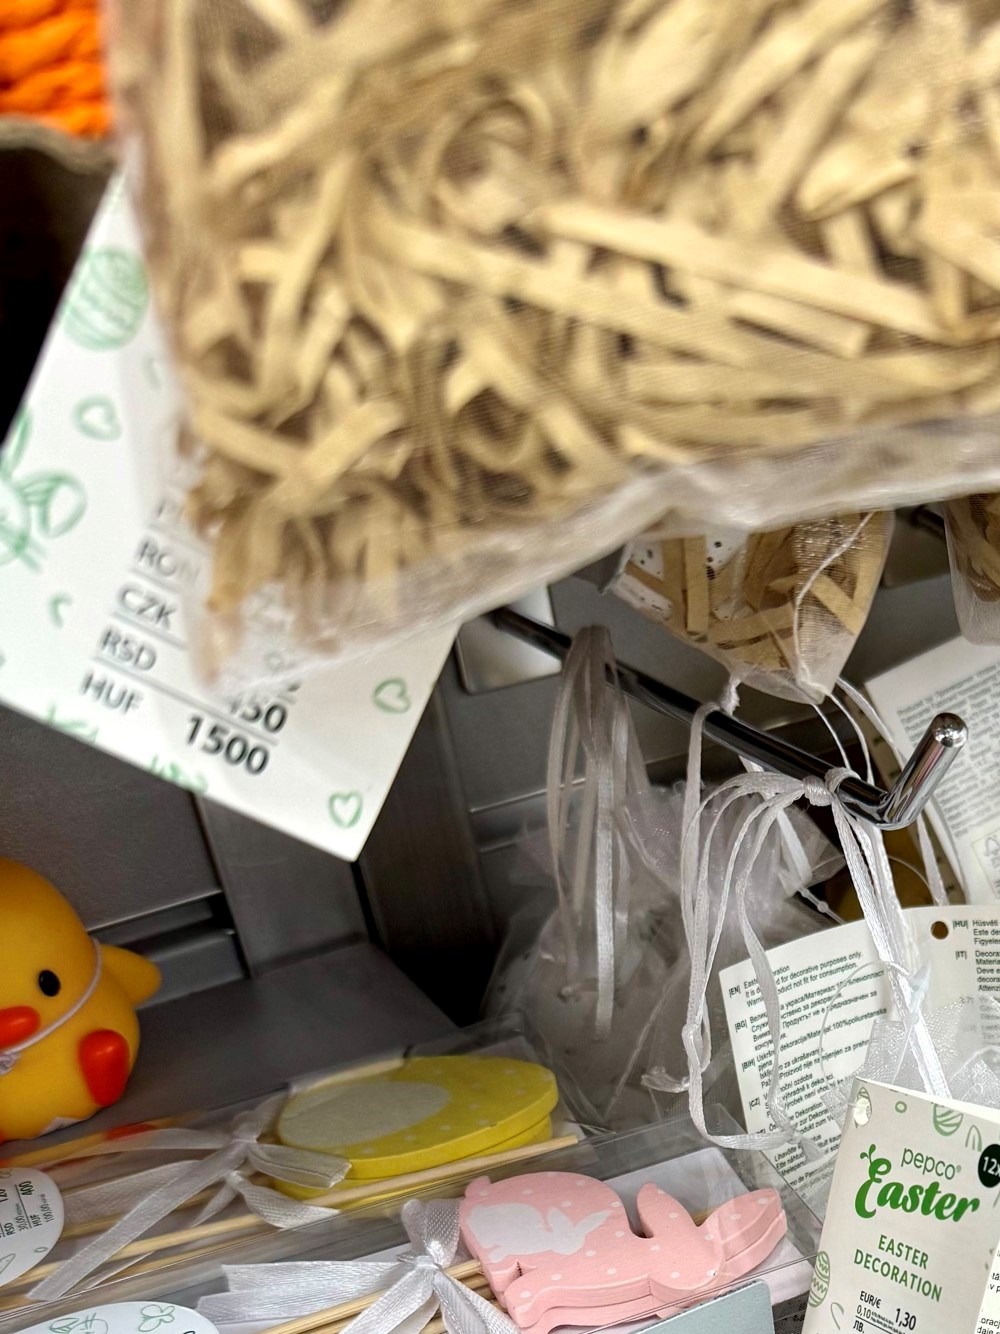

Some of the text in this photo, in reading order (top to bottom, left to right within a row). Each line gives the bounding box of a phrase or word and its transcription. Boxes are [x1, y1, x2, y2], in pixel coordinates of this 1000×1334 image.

[117, 582, 176, 630] CZK
[100, 628, 158, 672] RSD
[81, 671, 270, 776] HUF 1500
[855, 1150, 980, 1222] Easter
[878, 1234, 929, 1270] EASTER
[854, 1248, 943, 1303] DECORATION
[856, 1304, 871, 1319] 0,10
[860, 1290, 882, 1308] EUR/€
[894, 1307, 917, 1331] 1,30
